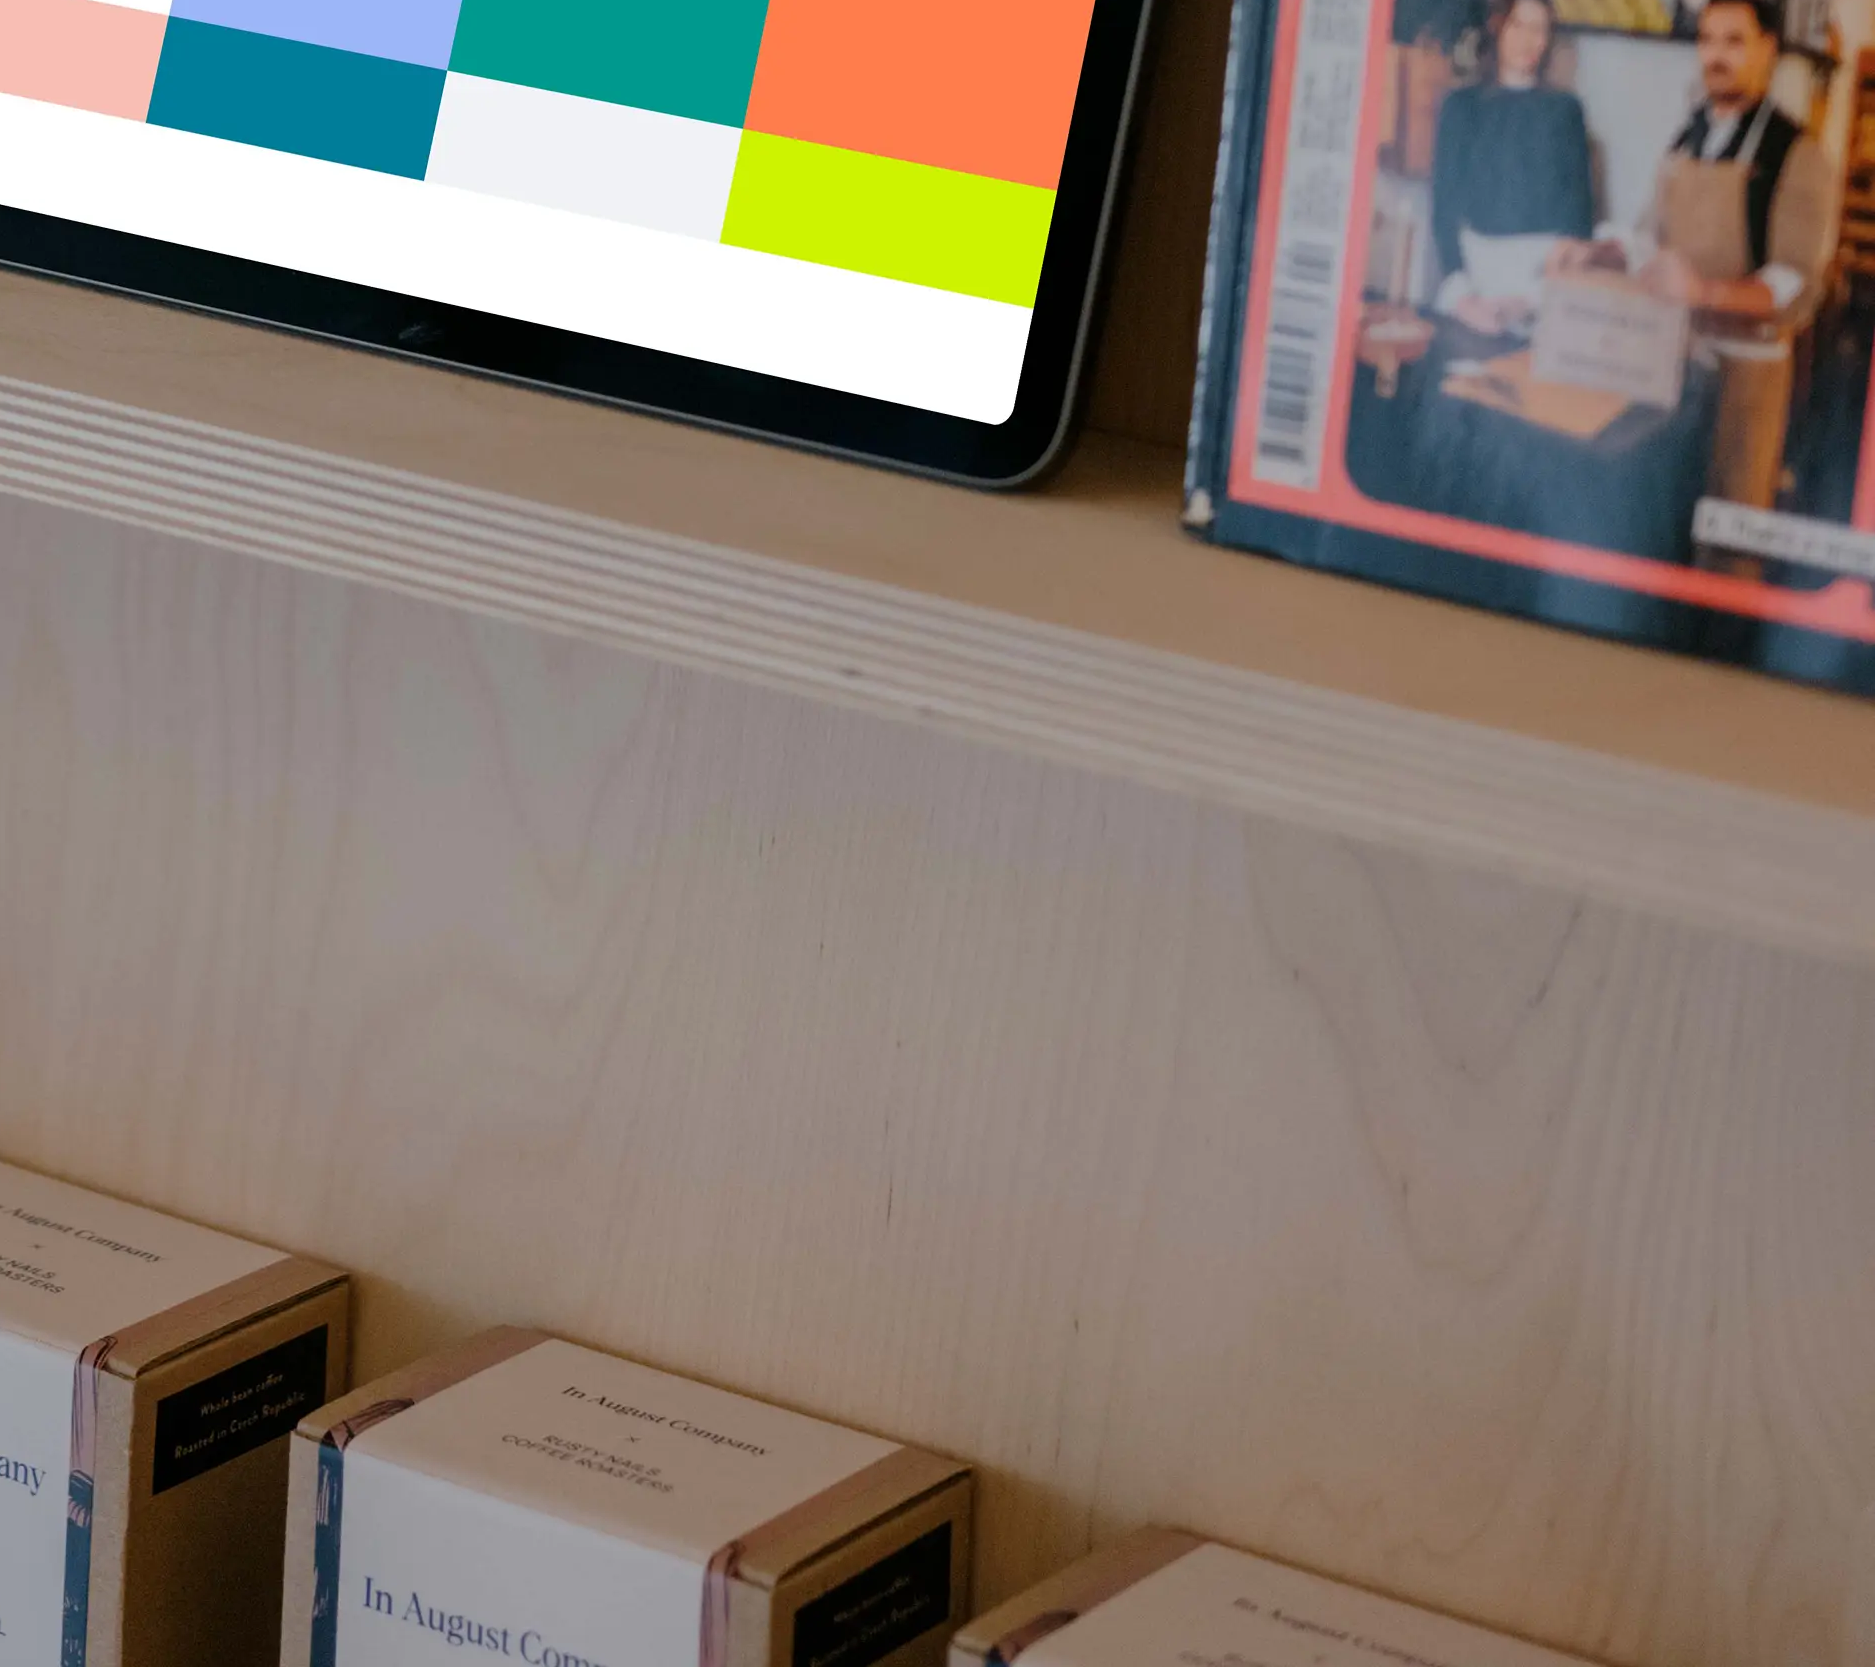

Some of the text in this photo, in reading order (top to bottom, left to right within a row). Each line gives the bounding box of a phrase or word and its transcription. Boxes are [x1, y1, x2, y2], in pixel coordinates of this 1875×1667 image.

[4, 1206, 74, 1235] August
[74, 1228, 173, 1264] Company
[5, 1258, 58, 1280] NAILS
[561, 1384, 773, 1457] In August Company
[174, 1430, 216, 1460] Roasted
[500, 1433, 575, 1463] COFFEE
[542, 1433, 605, 1458] RUSTY
[362, 1575, 394, 1616] In
[401, 1591, 511, 1656] August
